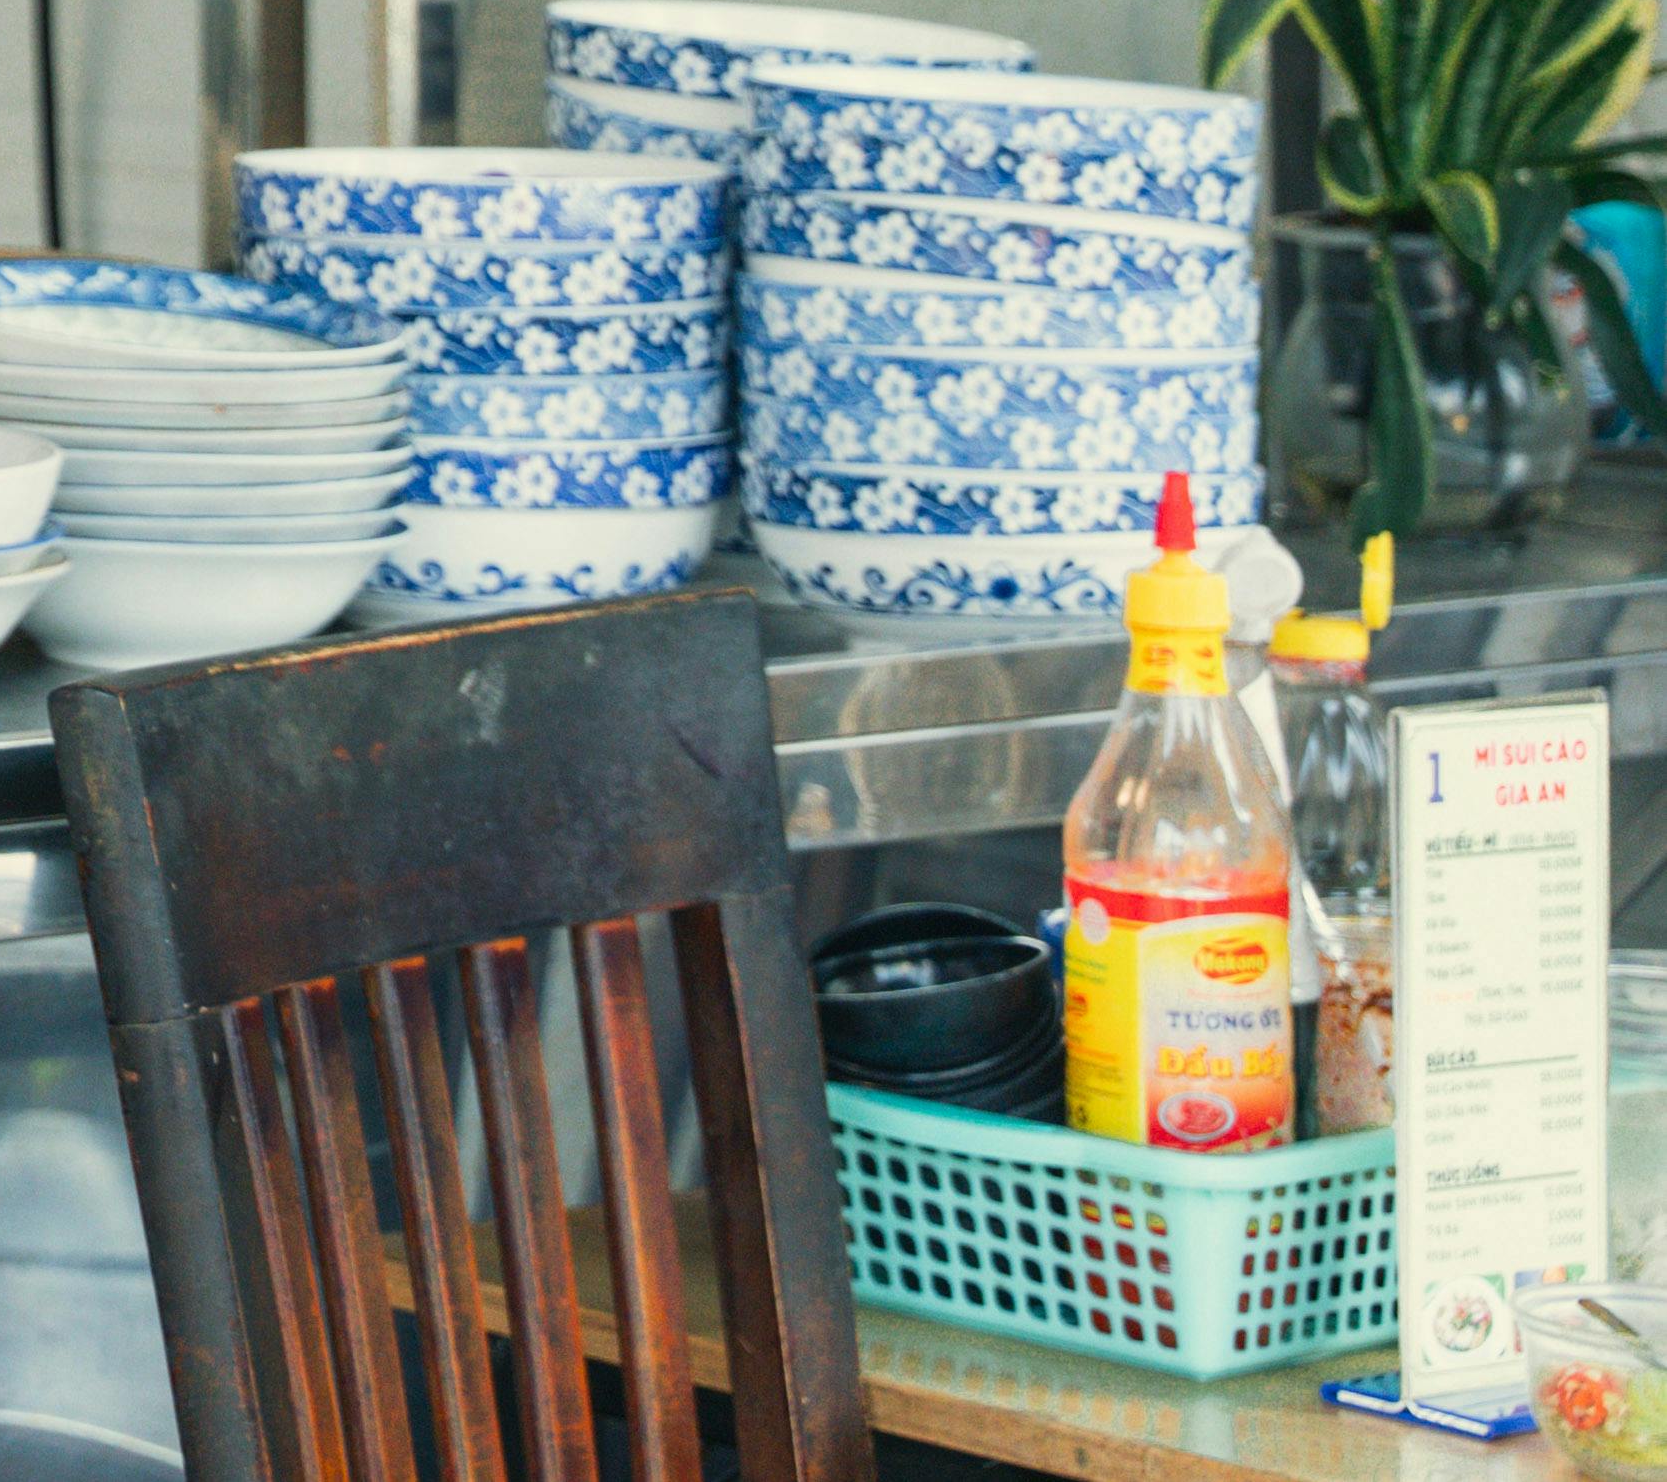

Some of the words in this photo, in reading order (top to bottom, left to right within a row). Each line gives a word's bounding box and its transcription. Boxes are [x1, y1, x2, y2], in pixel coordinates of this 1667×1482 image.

[1427, 751, 1445, 804] 1
[1495, 781, 1531, 808] GIA
[1537, 779, 1567, 803] AN
